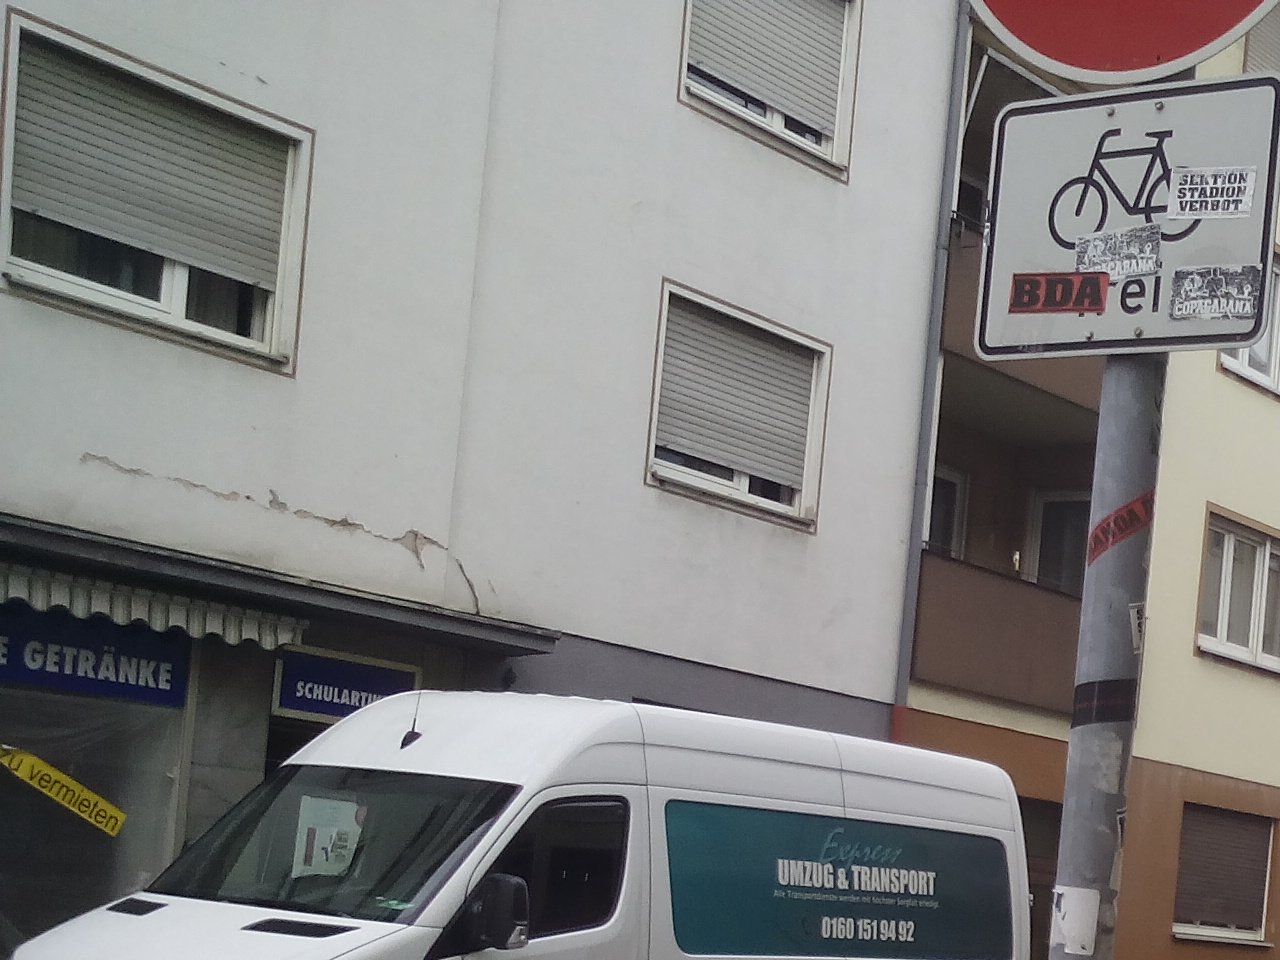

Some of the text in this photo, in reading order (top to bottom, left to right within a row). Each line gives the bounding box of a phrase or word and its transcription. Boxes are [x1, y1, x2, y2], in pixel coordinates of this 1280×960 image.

[1177, 185, 1247, 199] STADION
[1178, 199, 1243, 212] VERBOT
[1011, 276, 1101, 308] BDA
[1174, 299, 1252, 316] COPACABANA
[23, 640, 173, 690] GETRÄNKE
[29, 764, 119, 832] vermieten
[777, 858, 936, 896] UMZUG & TRANSPORT
[821, 916, 915, 943] 0160 151 94 92
